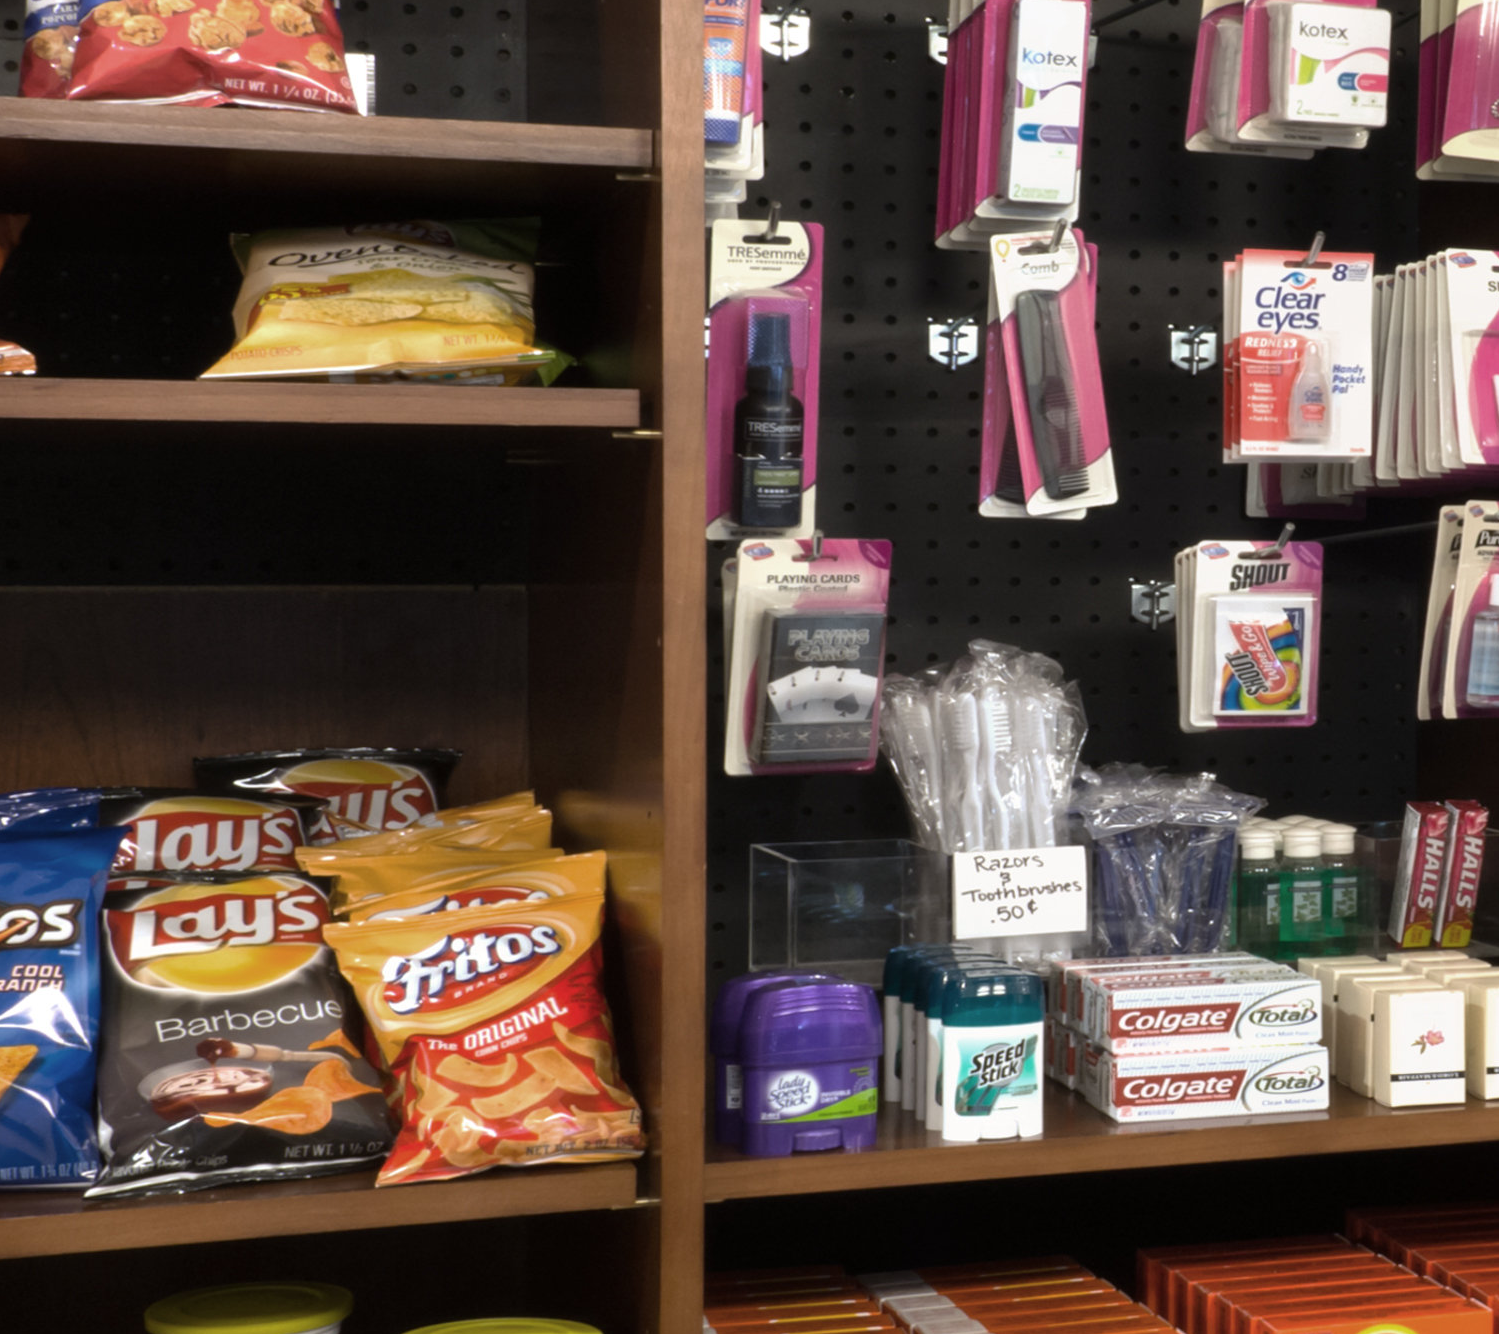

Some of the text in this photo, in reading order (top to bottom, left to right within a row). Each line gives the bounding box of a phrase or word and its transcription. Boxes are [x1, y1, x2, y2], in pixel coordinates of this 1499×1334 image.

[1020, 260, 1061, 275] Comb
[1254, 286, 1326, 311] Clear
[1256, 309, 1322, 335] eyes
[1331, 363, 1365, 377] Handy
[1331, 373, 1367, 387] Pocket
[1331, 383, 1350, 396] Pal
[766, 572, 861, 586] PLAYING CARDS
[1229, 562, 1292, 592] SHOUT
[973, 852, 1045, 873] Razors
[1417, 836, 1445, 909] HALLS
[960, 878, 1083, 904] Toothbrushes
[129, 888, 323, 961] Lay's
[10, 964, 64, 980] COOL
[382, 924, 562, 1013] Fritos
[453, 971, 509, 1000] BRAND
[154, 998, 344, 1043] Barbecue
[426, 995, 570, 1052] The ORIGINAL
[1117, 1004, 1312, 1035] Colgate Total
[474, 1032, 529, 1058] CORN CHIPS
